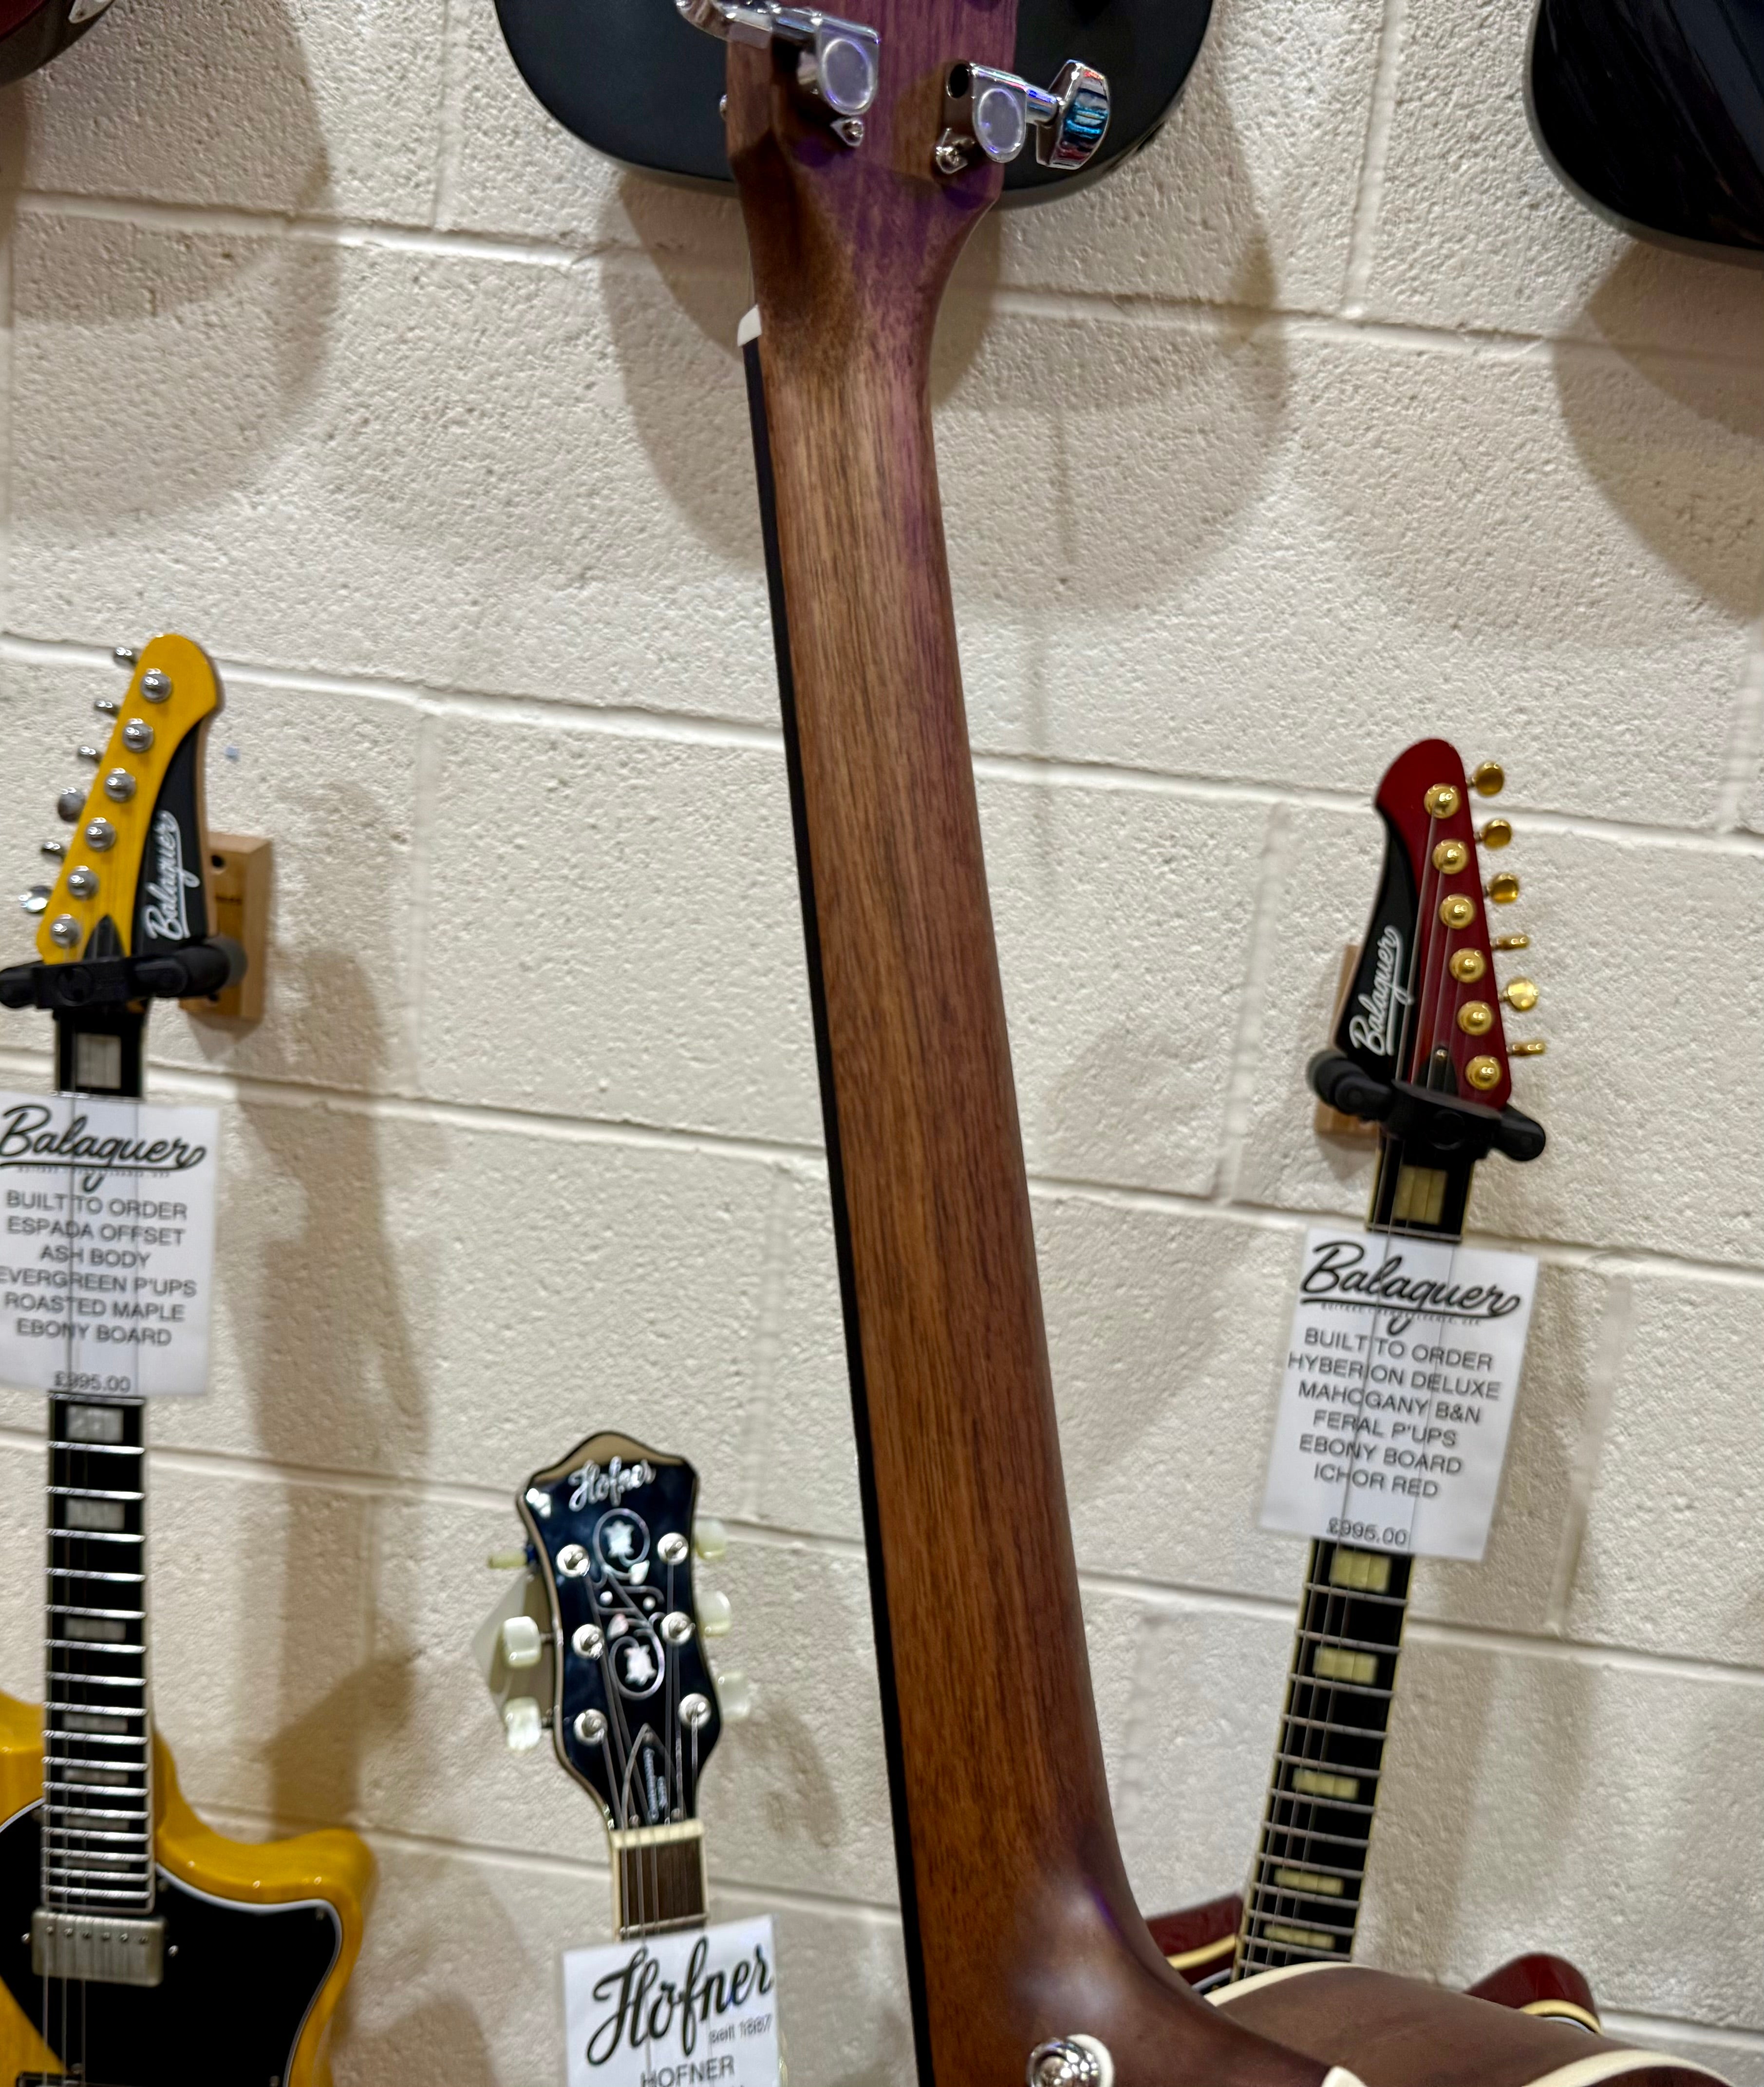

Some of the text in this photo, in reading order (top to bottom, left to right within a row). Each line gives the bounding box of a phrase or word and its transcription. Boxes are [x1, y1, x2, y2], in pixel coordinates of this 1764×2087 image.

[146, 810, 201, 941] Balaguer
[1349, 926, 1414, 1056] Balaguer
[0, 1103, 206, 1193] Balaguer
[6, 1189, 188, 1222] BUILT TO ORDER
[7, 1215, 187, 1247] ESPADA OFFSET
[39, 1244, 152, 1269] ASH BODY
[134, 1276, 198, 1298] P'UPS
[1299, 1240, 1520, 1336] Balaguer
[4, 1291, 186, 1323] ROASTED MAPLE
[16, 1317, 172, 1347] EBONY BOARD
[1304, 1327, 1494, 1373] BUILT TO ORDER
[1298, 1379, 1482, 1424] MAHOGANY B&N
[1410, 1370, 1502, 1402] DELUXE
[1313, 1408, 1458, 1449] FERAL P'UPS
[1299, 1432, 1464, 1475] EBONY BOARD
[1314, 1461, 1441, 1499] ICHOR RED
[640, 2055, 735, 2087] HOFNER
